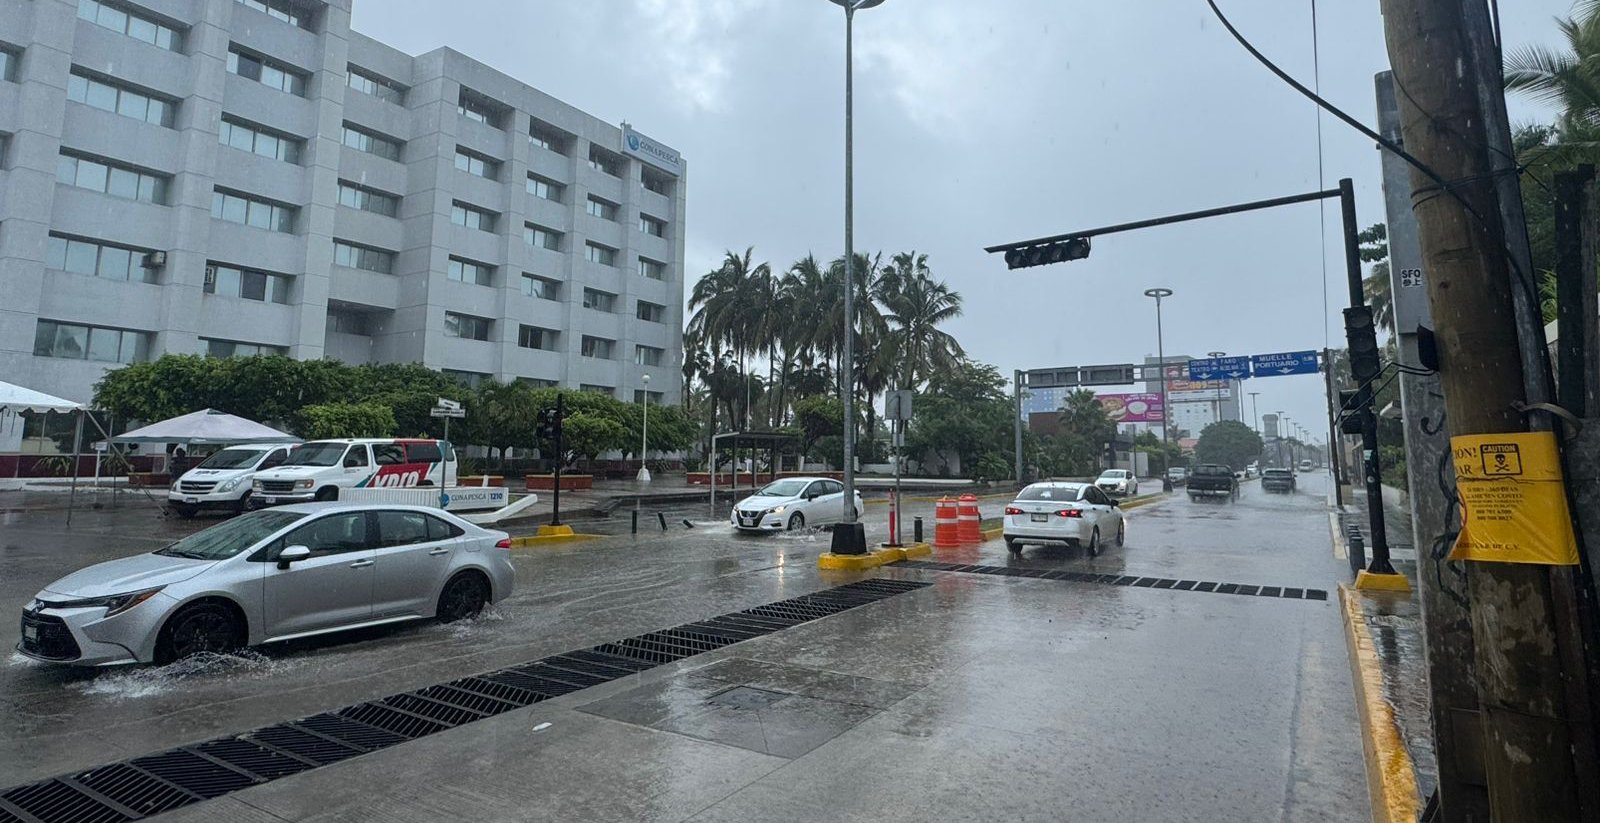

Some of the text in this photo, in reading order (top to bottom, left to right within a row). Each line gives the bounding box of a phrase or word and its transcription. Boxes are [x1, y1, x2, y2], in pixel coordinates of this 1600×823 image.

[640, 141, 679, 165] CONAPESCA
[1259, 354, 1292, 362] MUELLE
[1254, 360, 1299, 369] PORTUARIO
[1482, 445, 1516, 453] CAUTION
[451, 492, 487, 501] CONAPESCA
